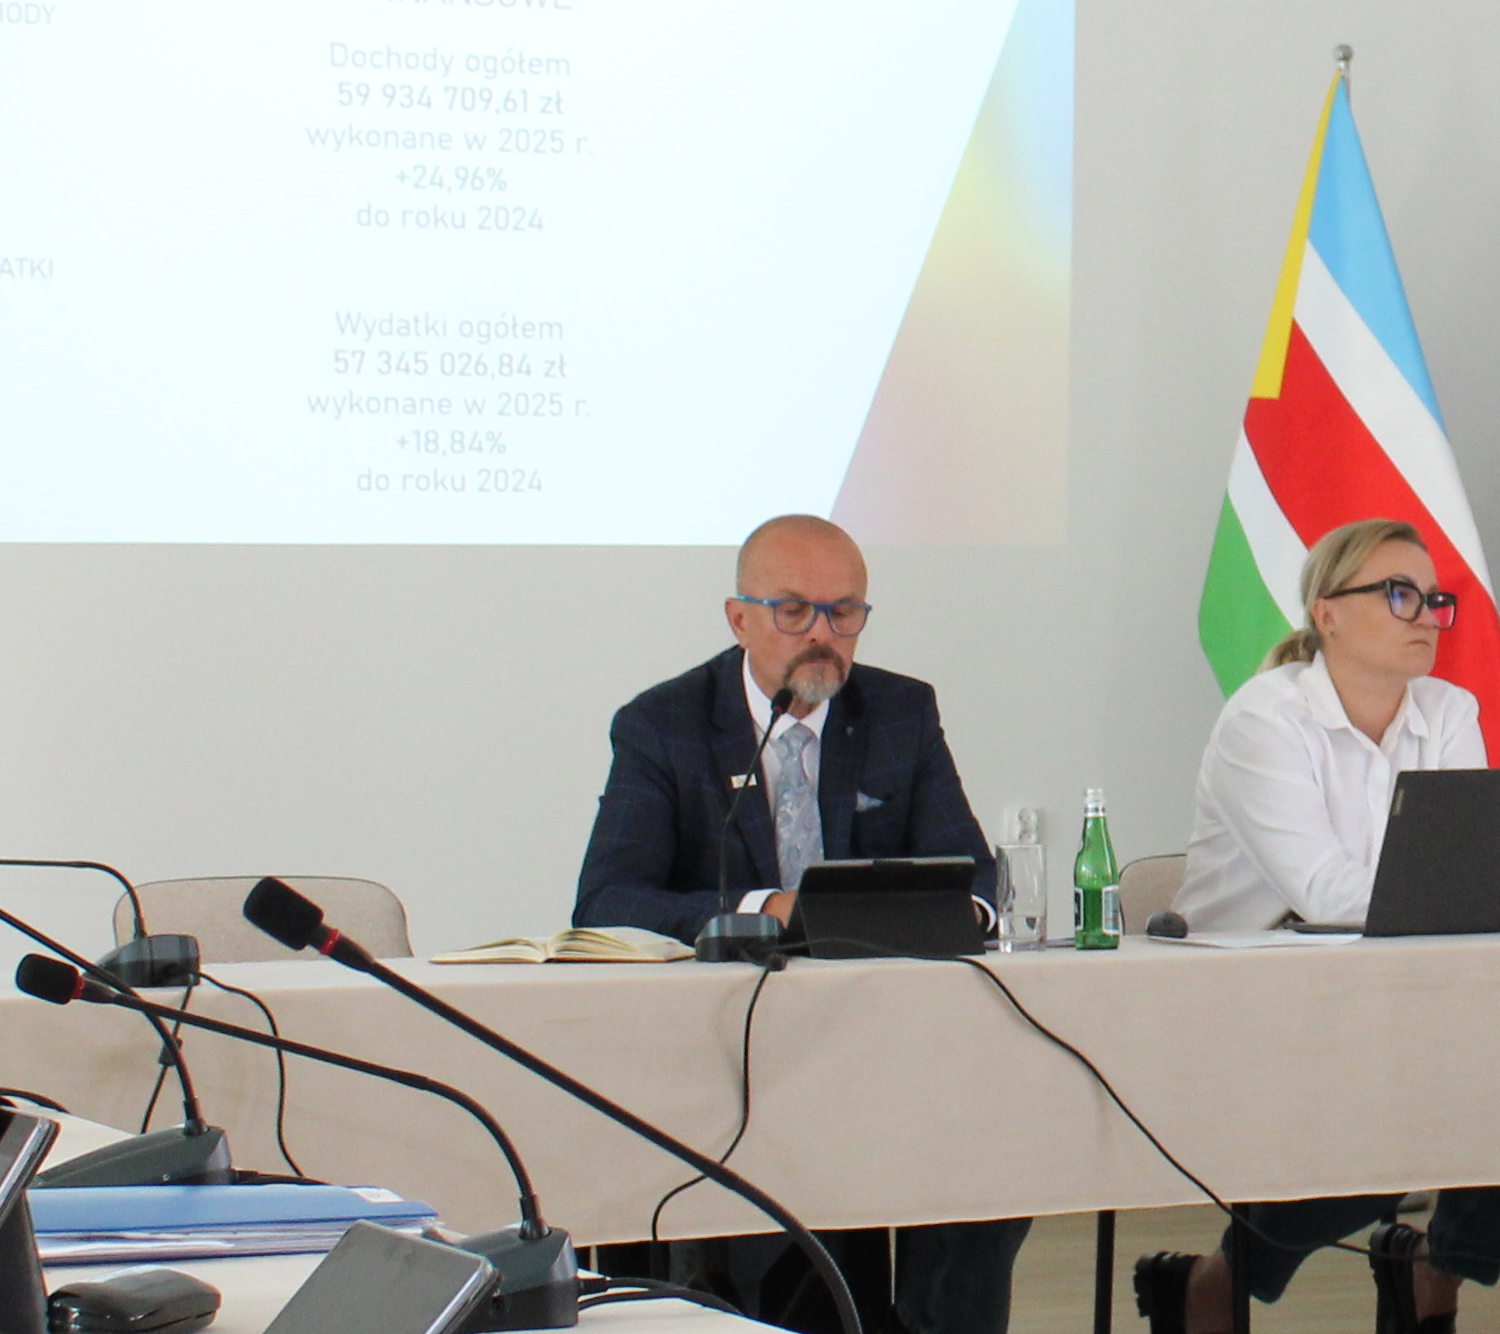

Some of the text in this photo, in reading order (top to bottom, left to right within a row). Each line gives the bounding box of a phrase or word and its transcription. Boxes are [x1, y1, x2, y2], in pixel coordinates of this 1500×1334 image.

[330, 43, 571, 79] Dochody ogółem
[337, 82, 564, 116] 59 934 709,61 zł
[306, 124, 593, 155] wykonane w 2025 r.
[396, 165, 508, 194] +24,96%
[356, 203, 544, 231] do roku 2024
[334, 311, 563, 344] Wydatki ogółem
[333, 350, 567, 380] 57 345 026,84 zł
[306, 390, 591, 420] wykonane w 2025 r.
[396, 431, 507, 458] +18,84%
[357, 468, 542, 492] do roku 2024
